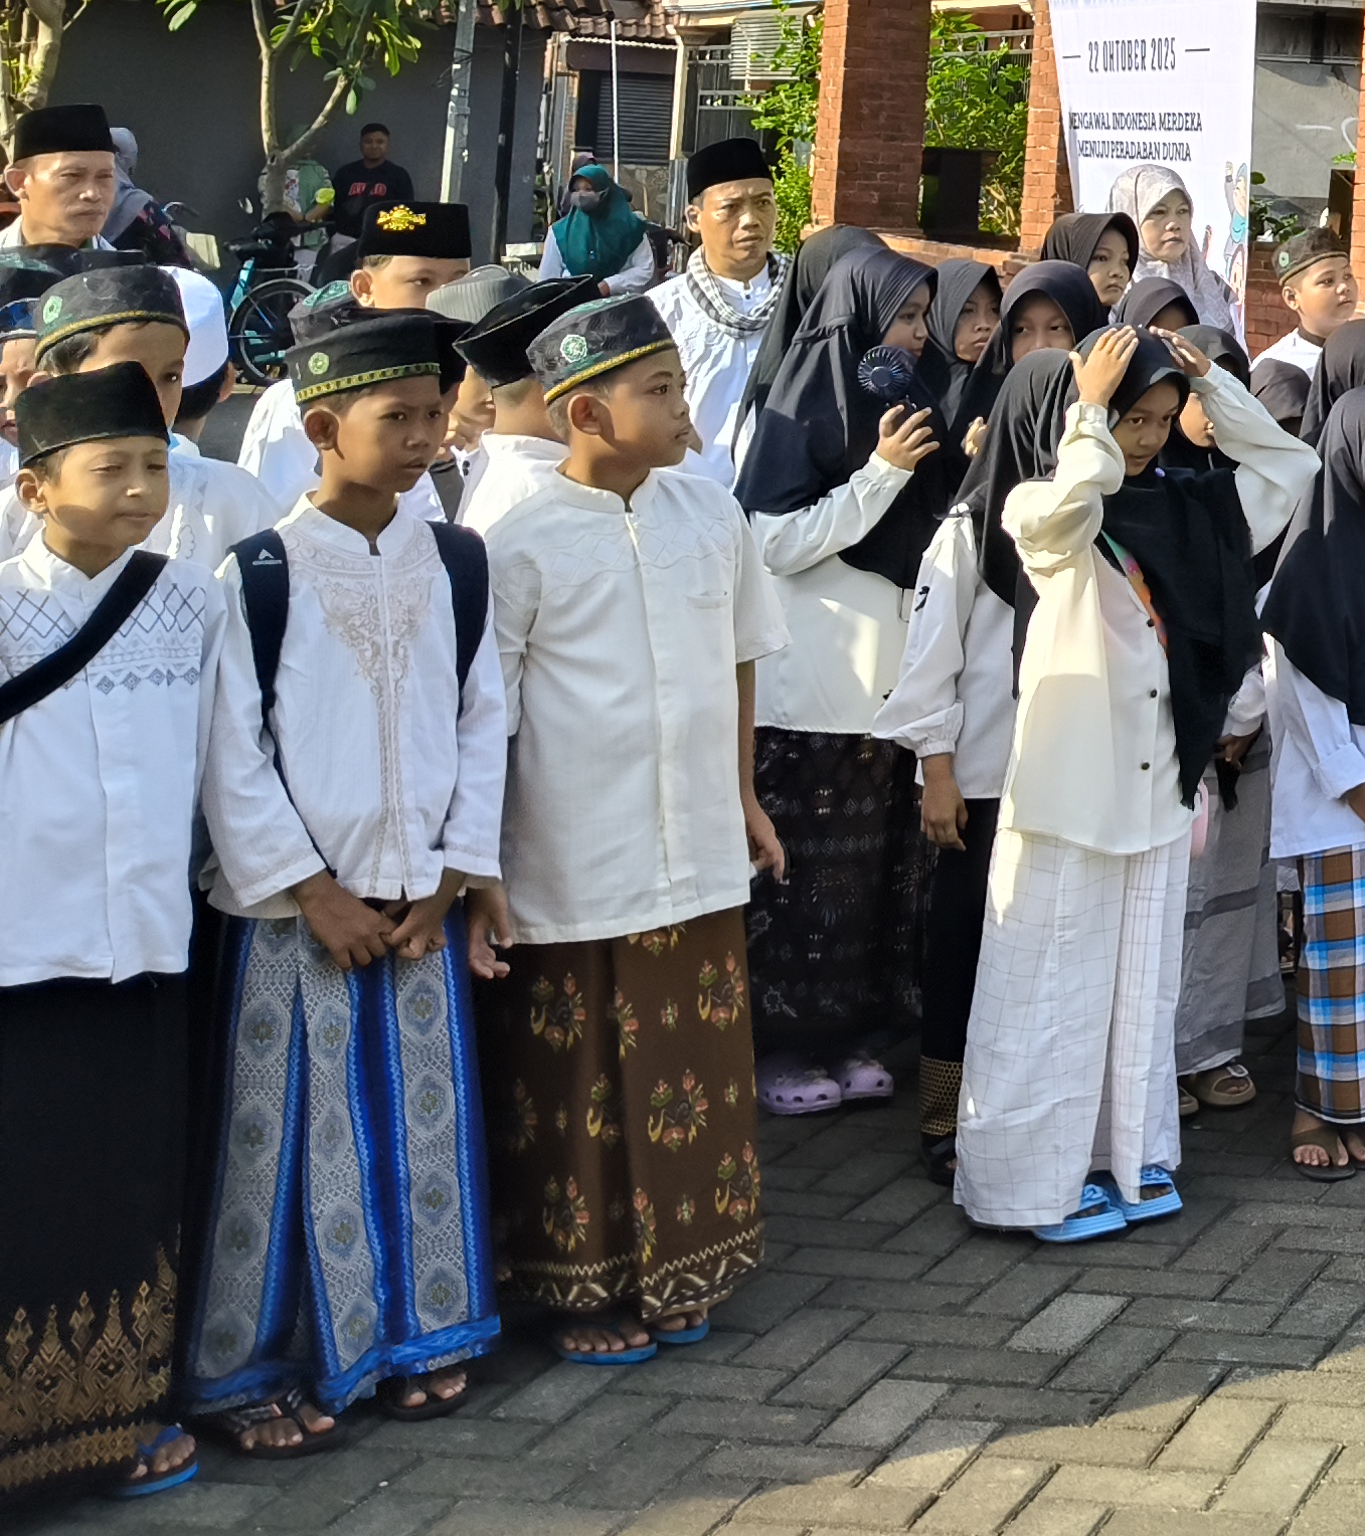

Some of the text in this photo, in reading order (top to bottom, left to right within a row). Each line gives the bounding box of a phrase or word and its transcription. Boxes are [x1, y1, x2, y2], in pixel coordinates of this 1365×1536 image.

[1088, 41, 1099, 73] 22
[1151, 37, 1176, 71] 2025
[1112, 112, 1157, 131] INDONESIA
[1159, 112, 1203, 132] MERDEKA
[1077, 140, 1192, 162] MENUJU PERADABAN DUNIA
